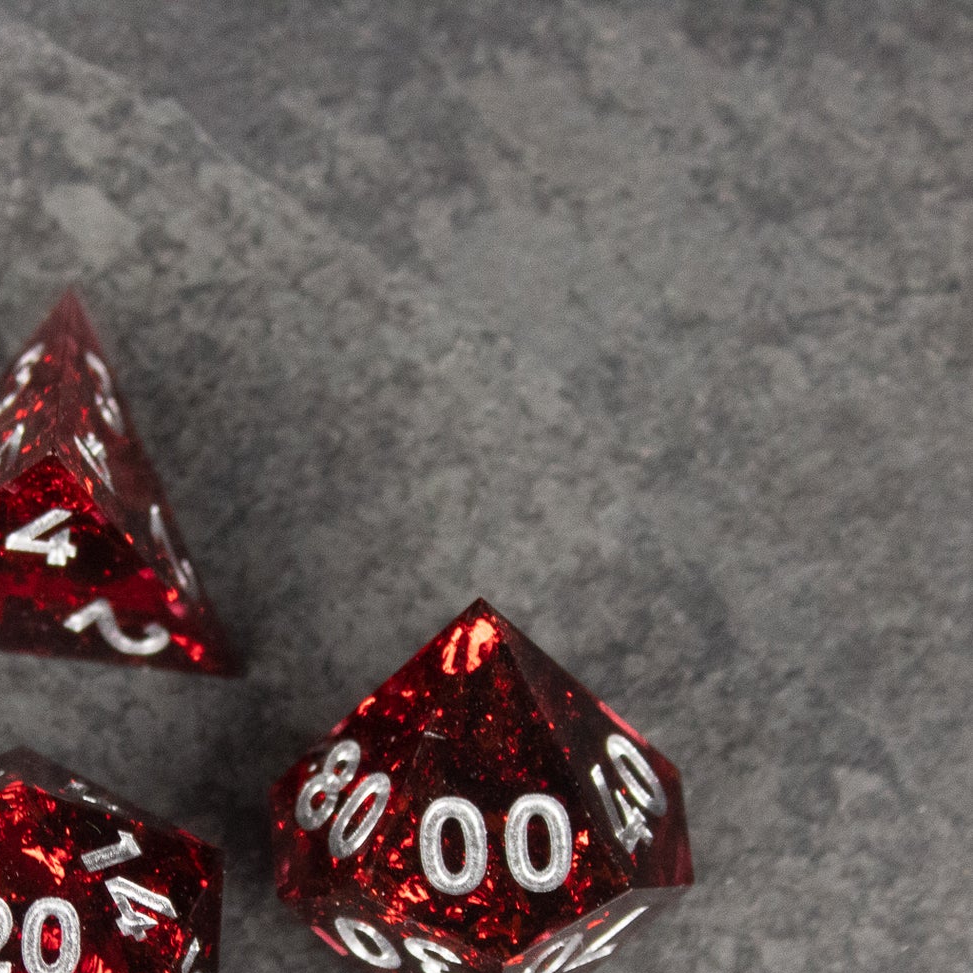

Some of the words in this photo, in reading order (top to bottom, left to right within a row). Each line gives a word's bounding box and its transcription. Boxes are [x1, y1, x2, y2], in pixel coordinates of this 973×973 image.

[4, 508, 78, 567] 4
[62, 598, 171, 656] 2
[295, 738, 392, 861] 80
[418, 791, 574, 897] 00
[590, 732, 669, 855] 40
[80, 829, 179, 942] 14
